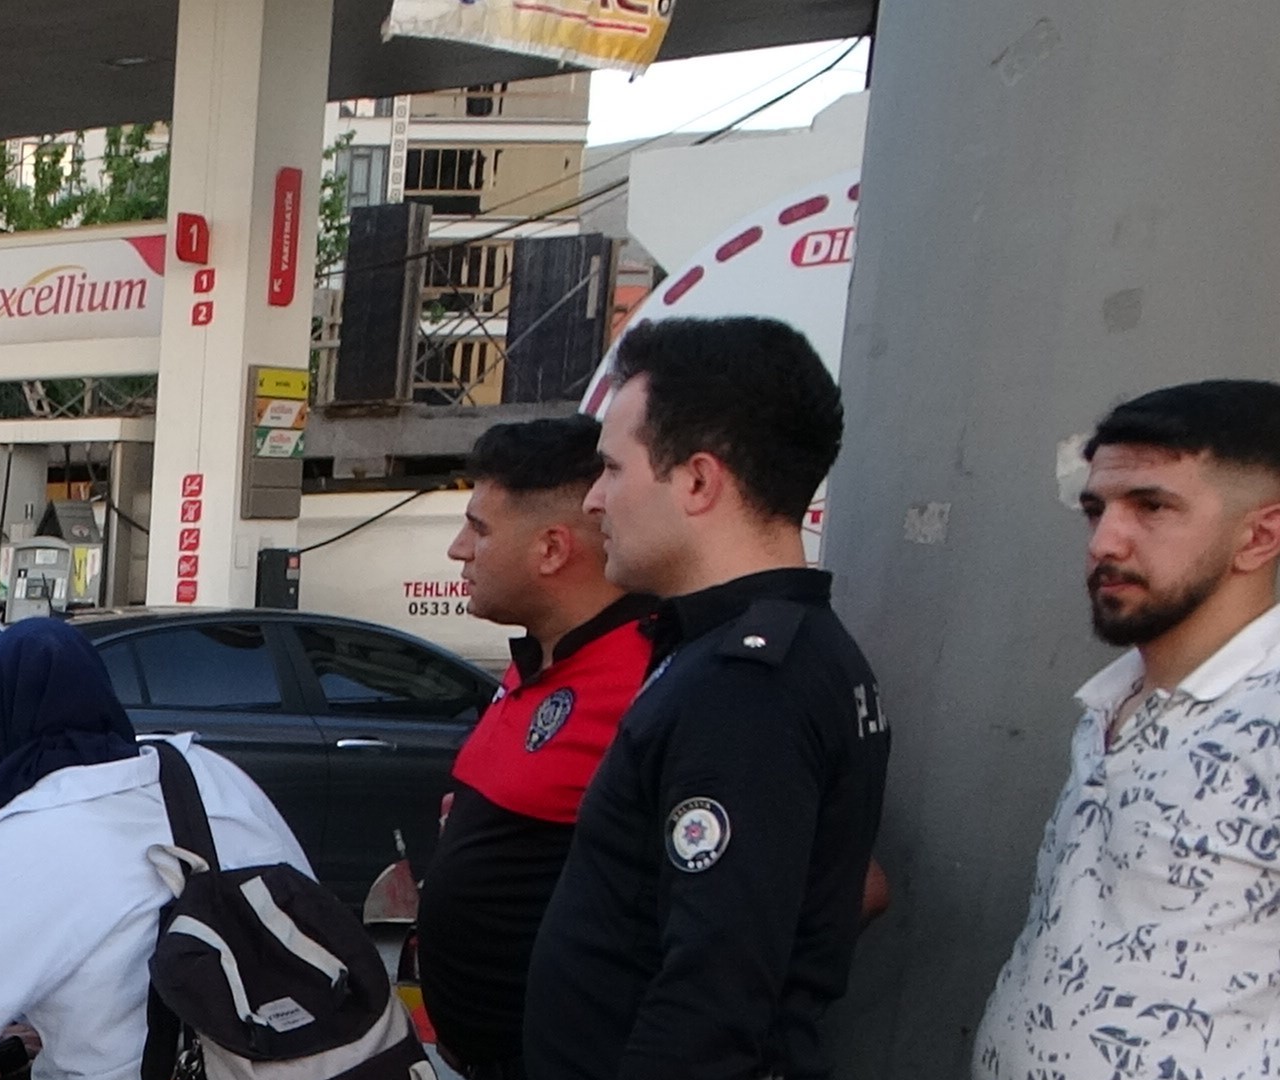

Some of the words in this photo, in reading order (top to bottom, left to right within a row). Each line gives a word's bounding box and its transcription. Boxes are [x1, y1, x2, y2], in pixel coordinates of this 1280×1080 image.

[189, 224, 198, 253] 1
[200, 274, 208, 290] 1
[197, 306, 207, 322] 2
[408, 602, 450, 615] 0533
